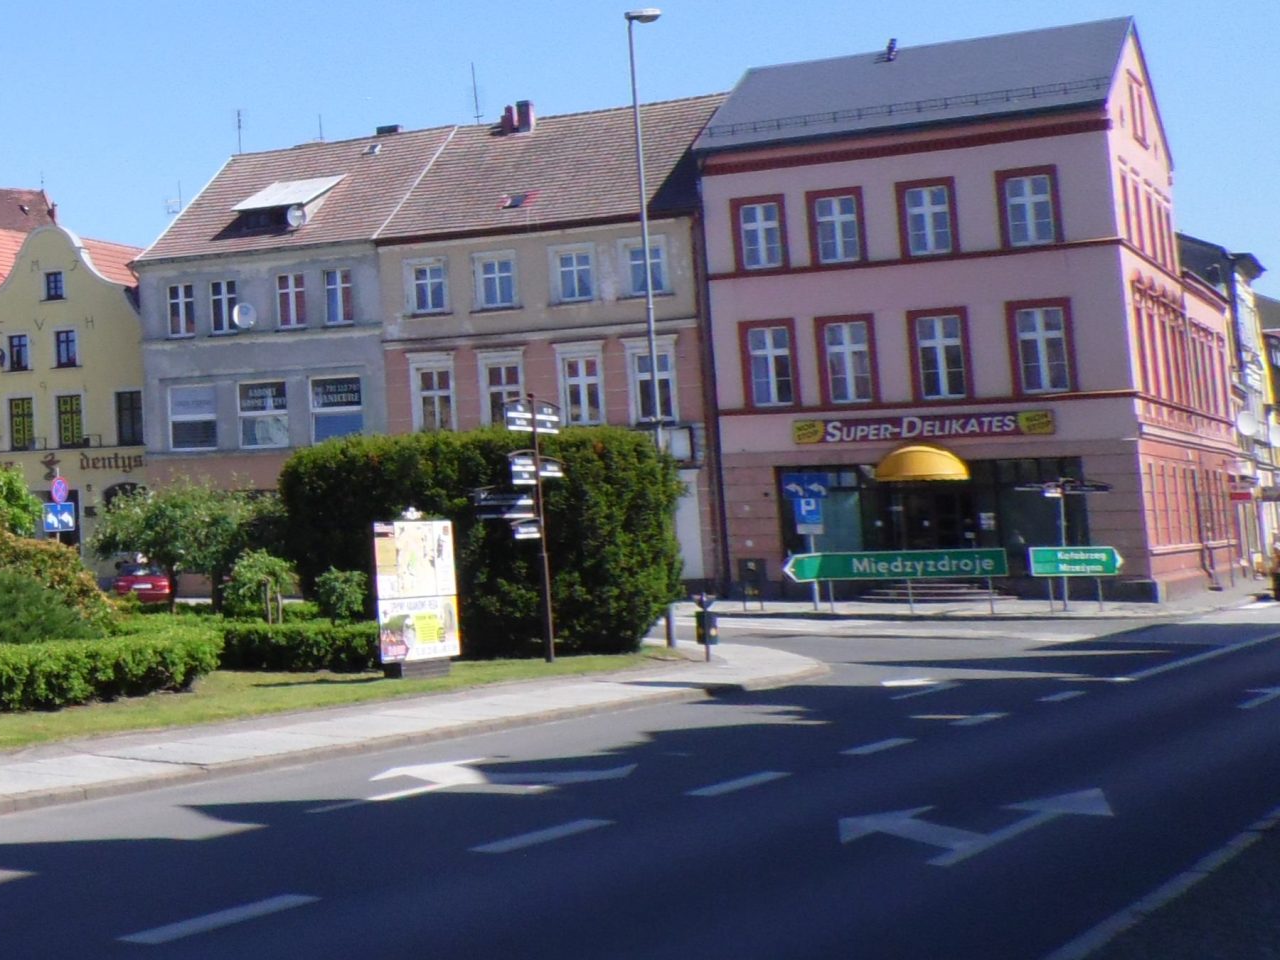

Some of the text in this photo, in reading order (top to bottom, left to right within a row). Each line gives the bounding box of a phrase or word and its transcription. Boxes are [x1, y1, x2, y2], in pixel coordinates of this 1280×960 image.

[315, 392, 360, 404] ANICURE
[825, 416, 1016, 442] SUPER-DELIKATES
[801, 498, 816, 515] P
[852, 555, 995, 577] Międzyzdroje
